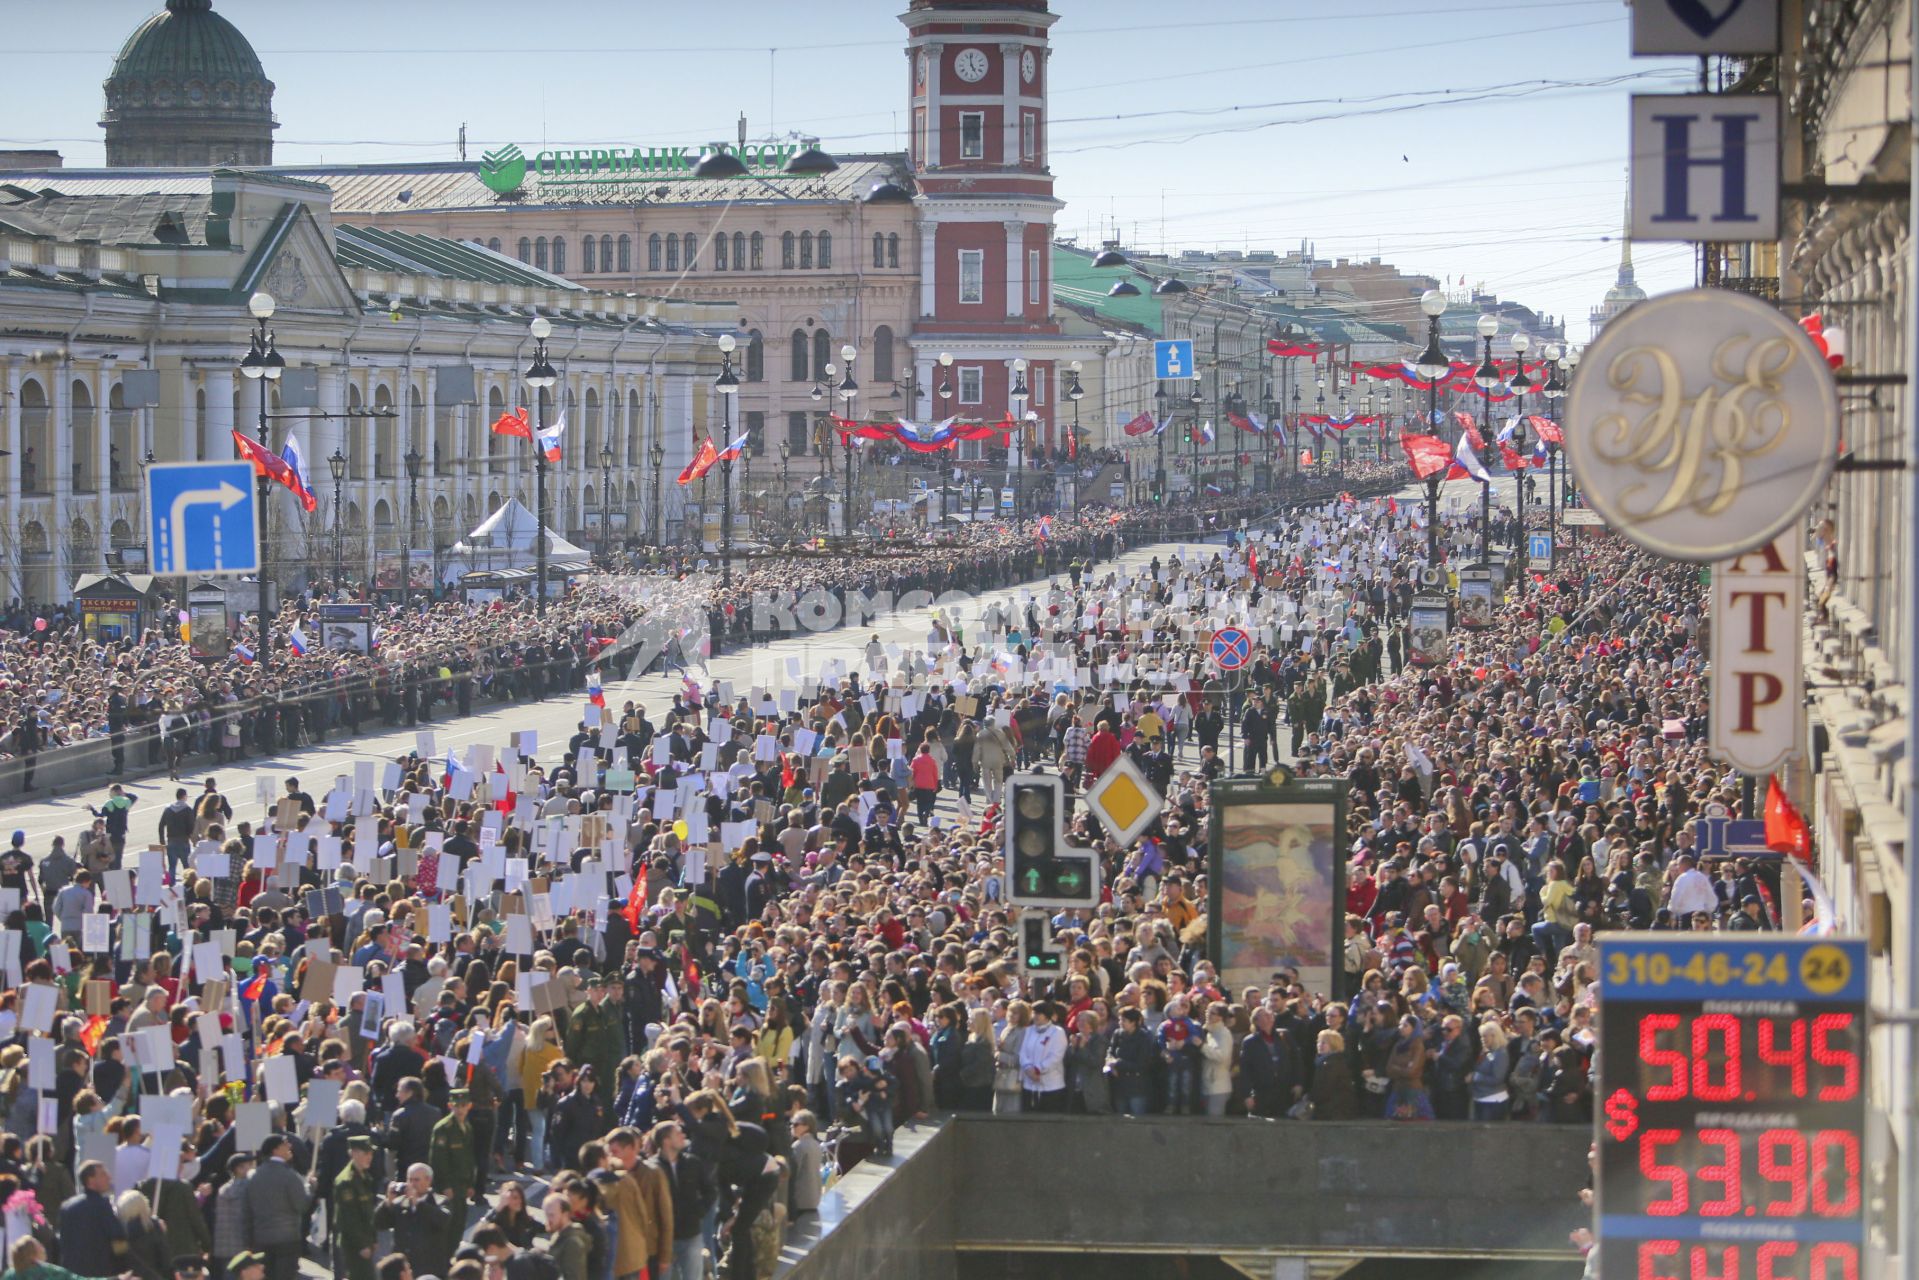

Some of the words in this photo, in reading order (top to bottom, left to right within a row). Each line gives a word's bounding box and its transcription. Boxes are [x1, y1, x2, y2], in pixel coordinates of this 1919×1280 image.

[535, 147, 690, 176] СБЕРБАНК
[1607, 952, 1789, 985] 310-46-24
[1806, 957, 1844, 980] 24
[1639, 1013, 1860, 1102] 50.45
[1604, 1088, 1639, 1142] $
[1639, 1129, 1861, 1217] 53.90
